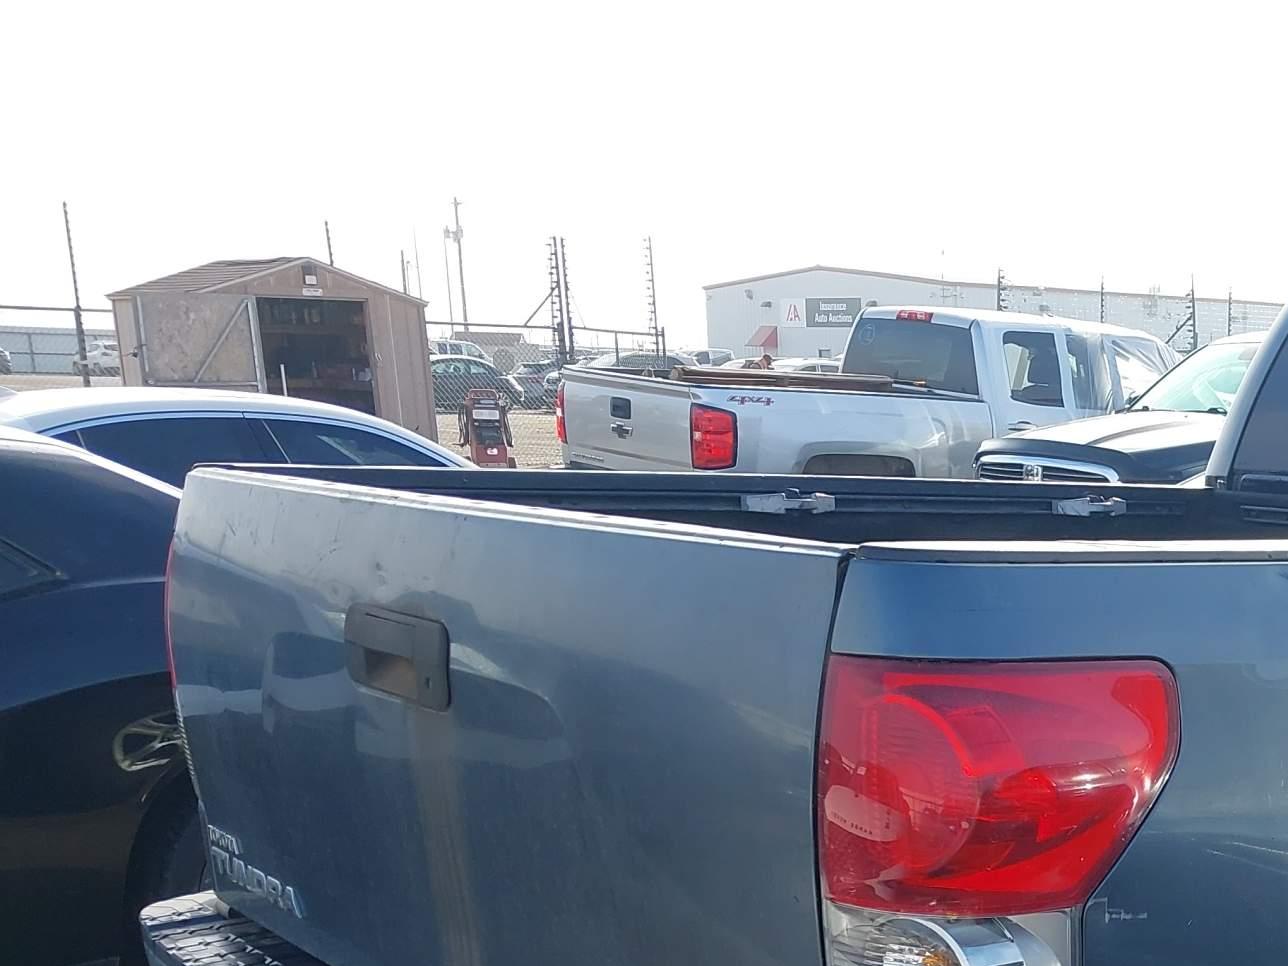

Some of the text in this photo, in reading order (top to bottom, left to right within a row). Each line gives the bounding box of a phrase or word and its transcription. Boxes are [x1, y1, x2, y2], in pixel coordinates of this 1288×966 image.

[819, 301, 847, 311] Insurance
[815, 312, 853, 323] Auto Auctions
[209, 845, 304, 919] TUNDRA
